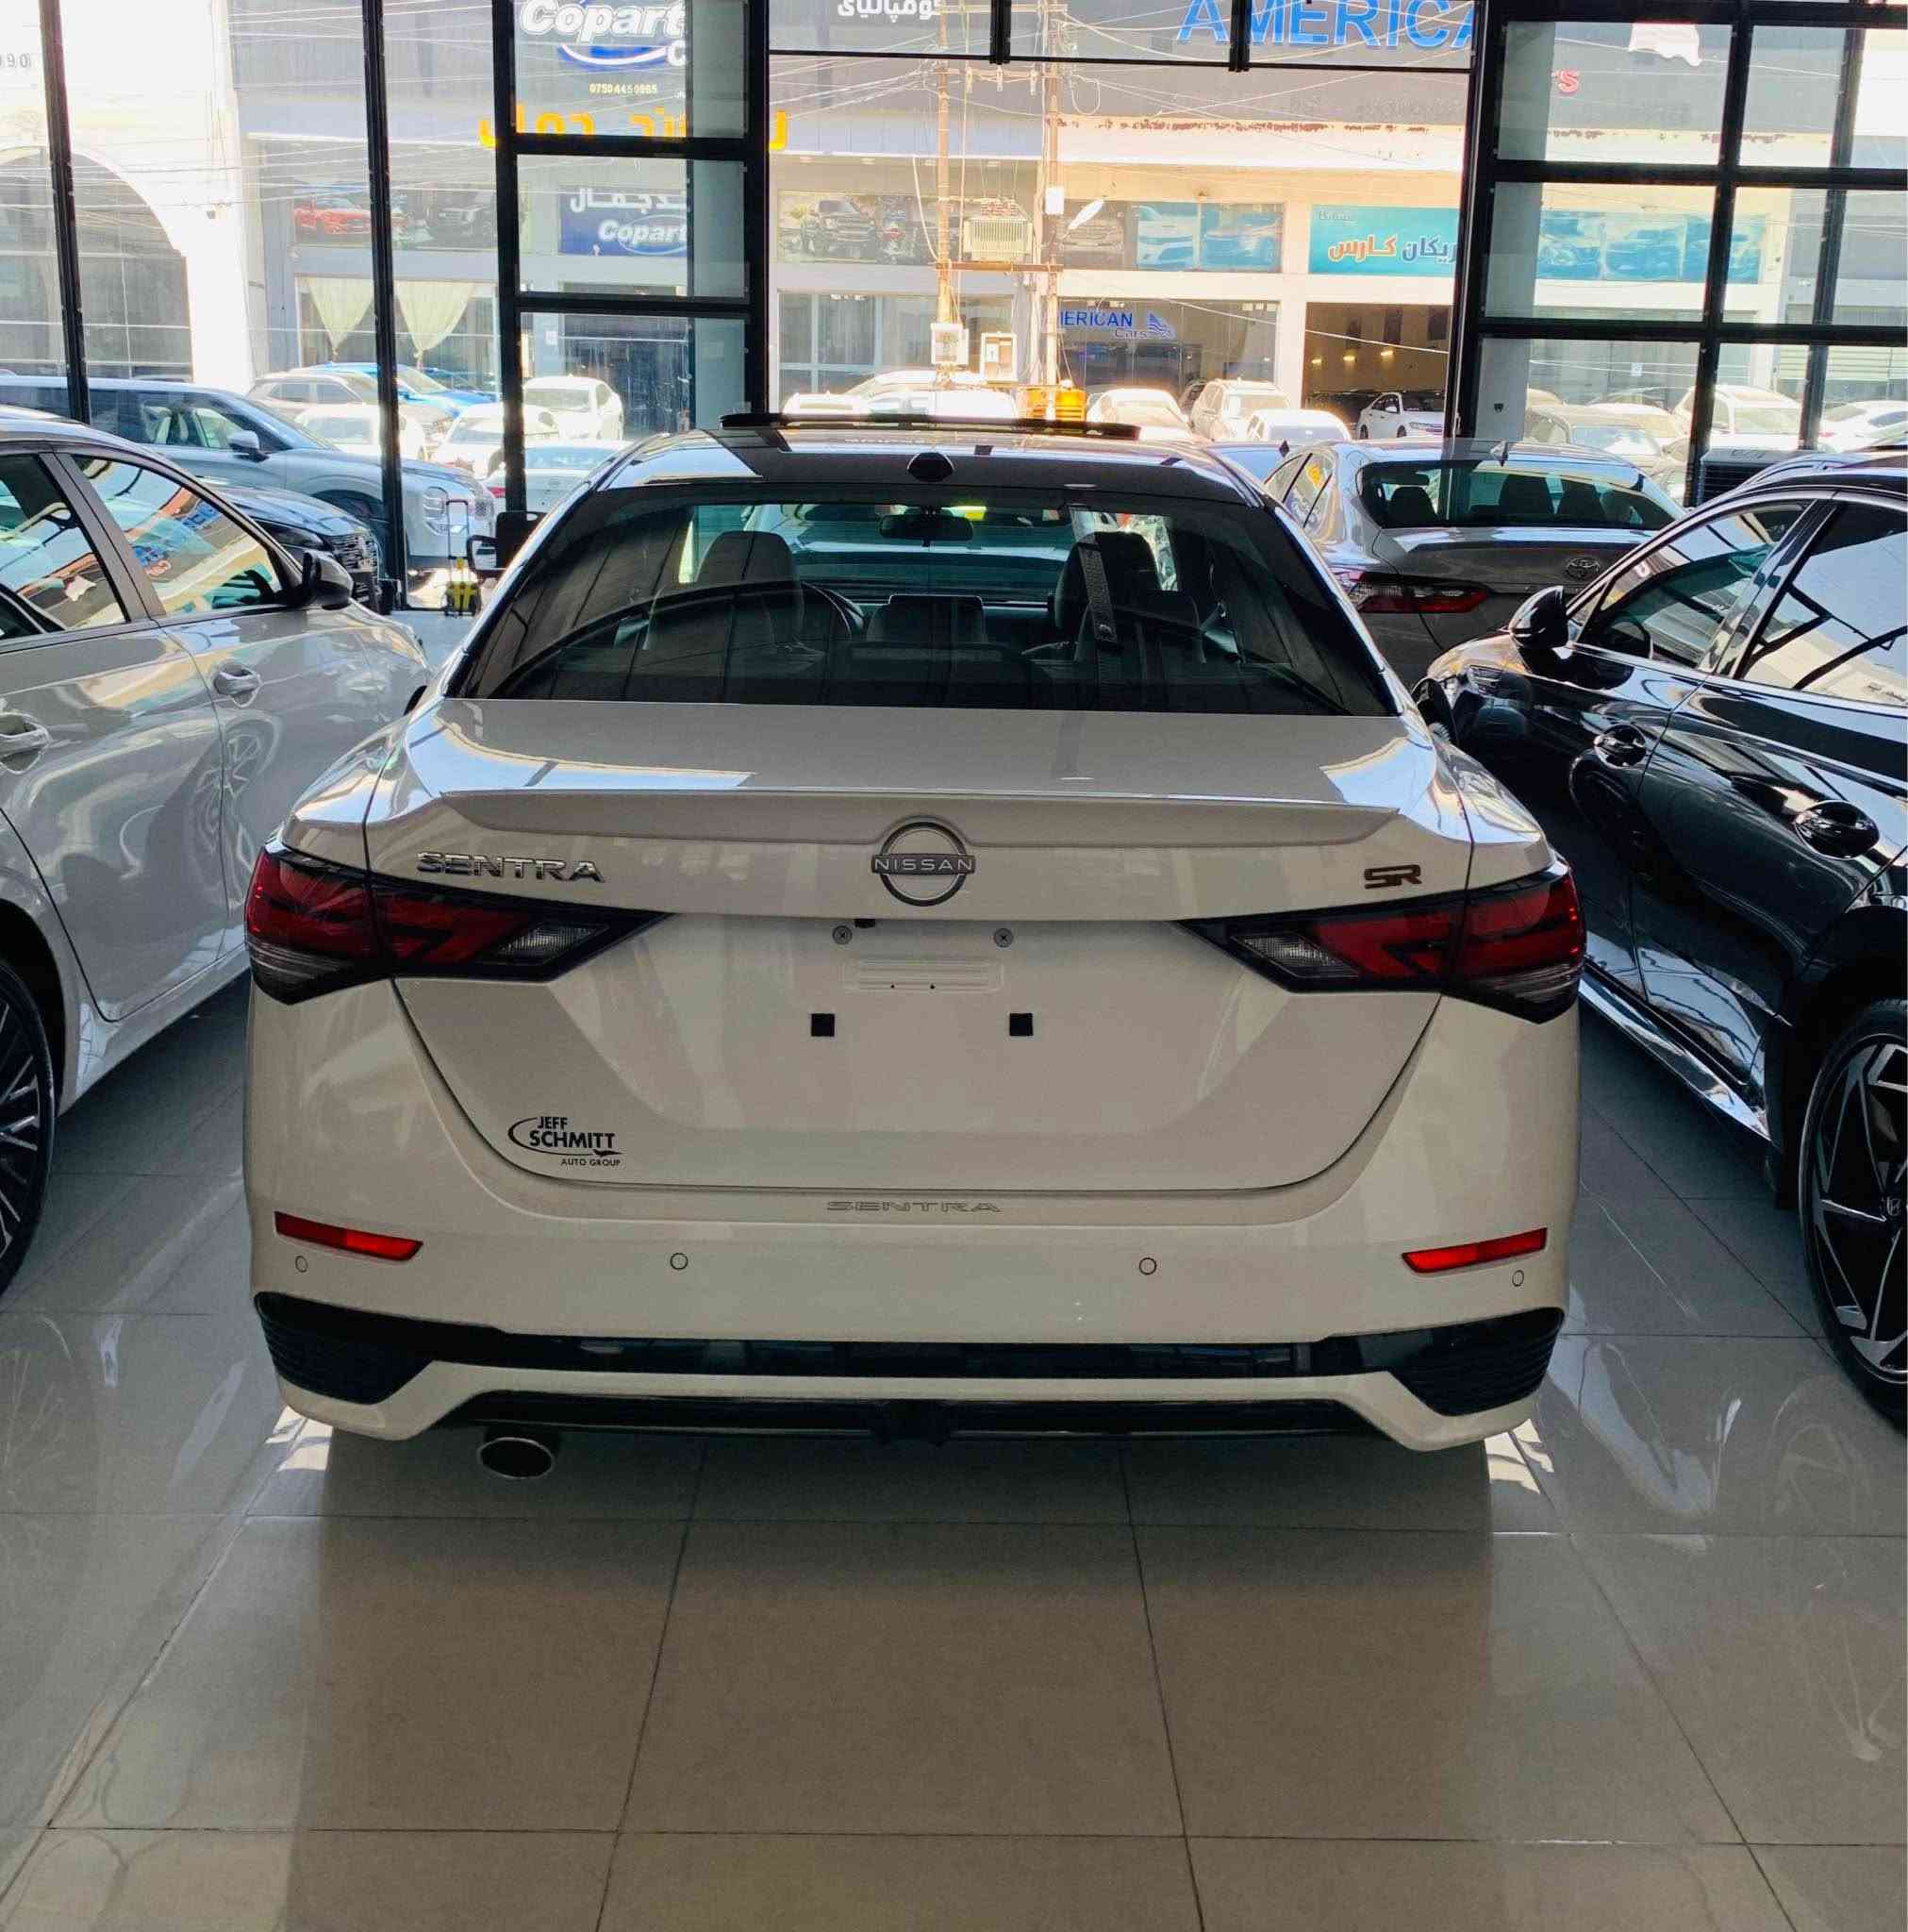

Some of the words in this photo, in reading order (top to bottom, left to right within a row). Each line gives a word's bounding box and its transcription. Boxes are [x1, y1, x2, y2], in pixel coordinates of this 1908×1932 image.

[520, 0, 687, 45] Copart
[1060, 309, 1133, 327] ERICAN
[416, 851, 606, 883] SENTRA
[873, 858, 972, 872] NISSAN
[1364, 864, 1422, 890] SR
[538, 1116, 568, 1129] JEFF
[529, 1130, 615, 1148] SCHMITT
[826, 1201, 1003, 1212] SENTRA
